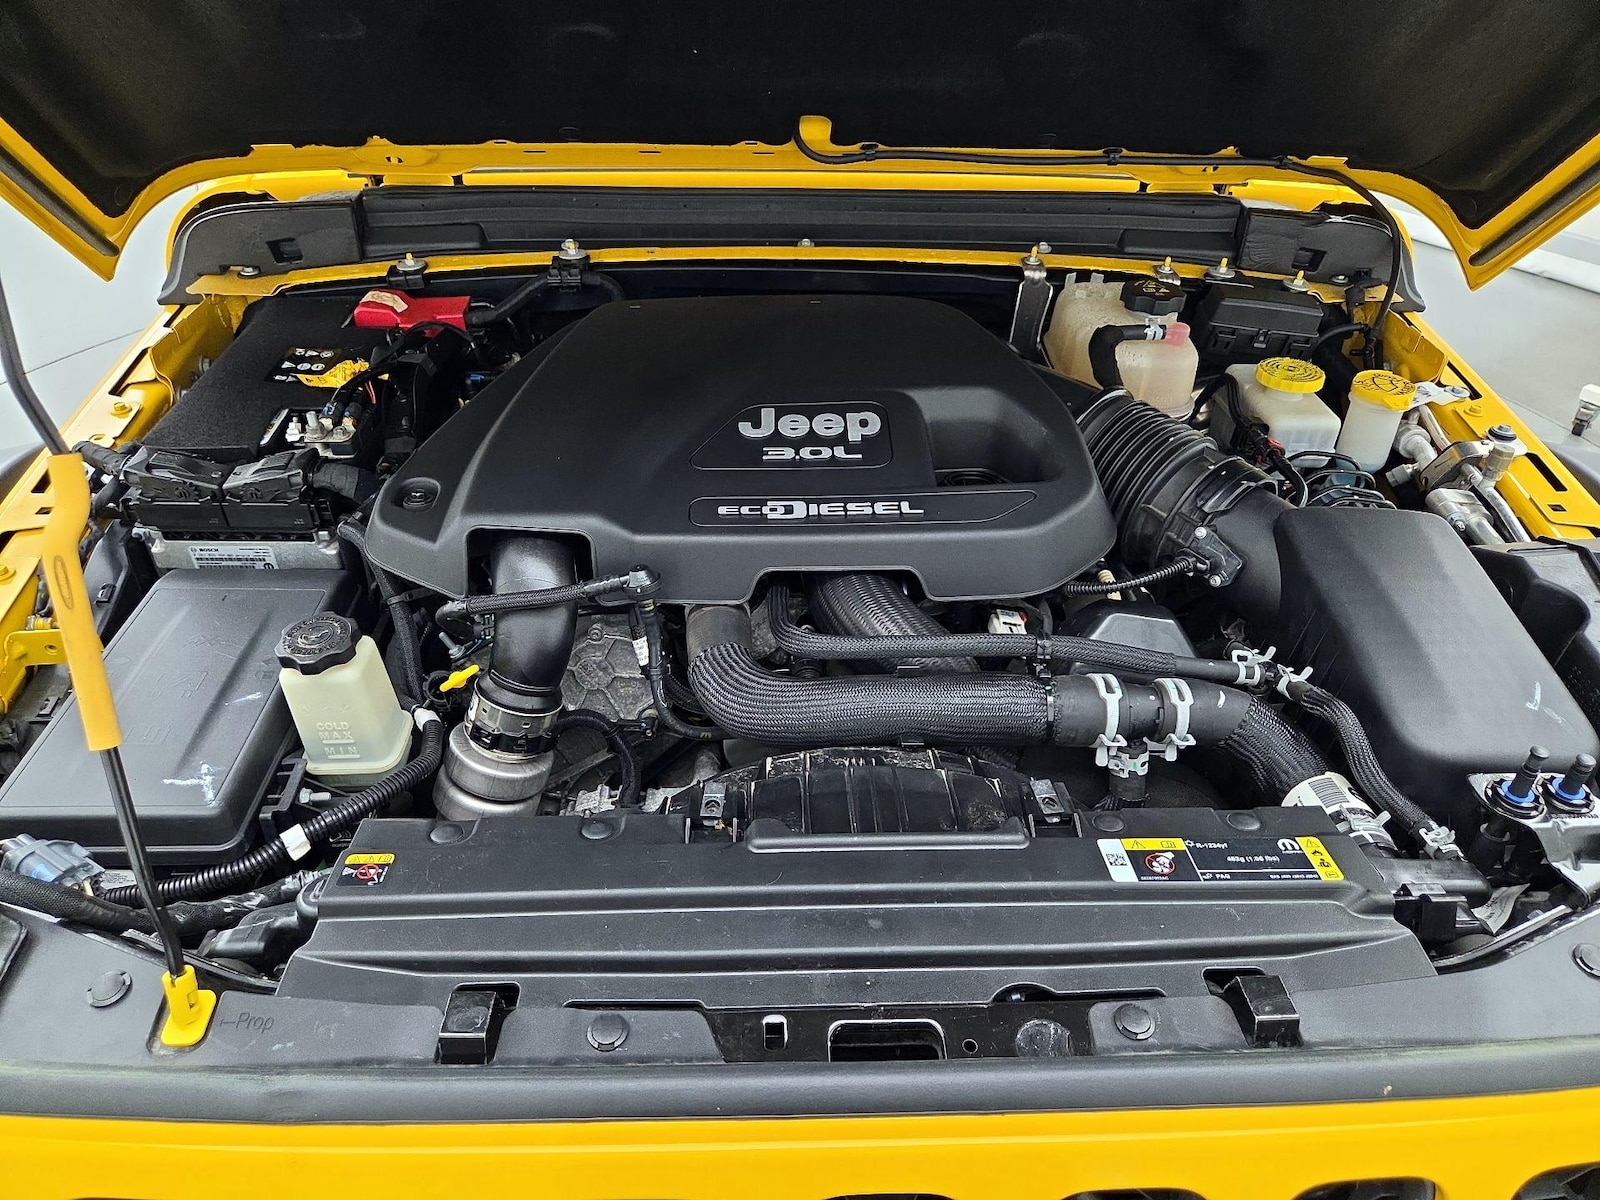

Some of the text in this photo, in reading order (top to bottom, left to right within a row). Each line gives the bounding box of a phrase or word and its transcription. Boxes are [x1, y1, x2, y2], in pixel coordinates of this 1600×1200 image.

[738, 408, 881, 442] Jeep
[762, 446, 862, 461] 3.0L
[316, 721, 349, 730] COLD
[318, 731, 353, 740] MAX
[324, 746, 359, 755] MIN
[236, 1012, 275, 1034] Prop
